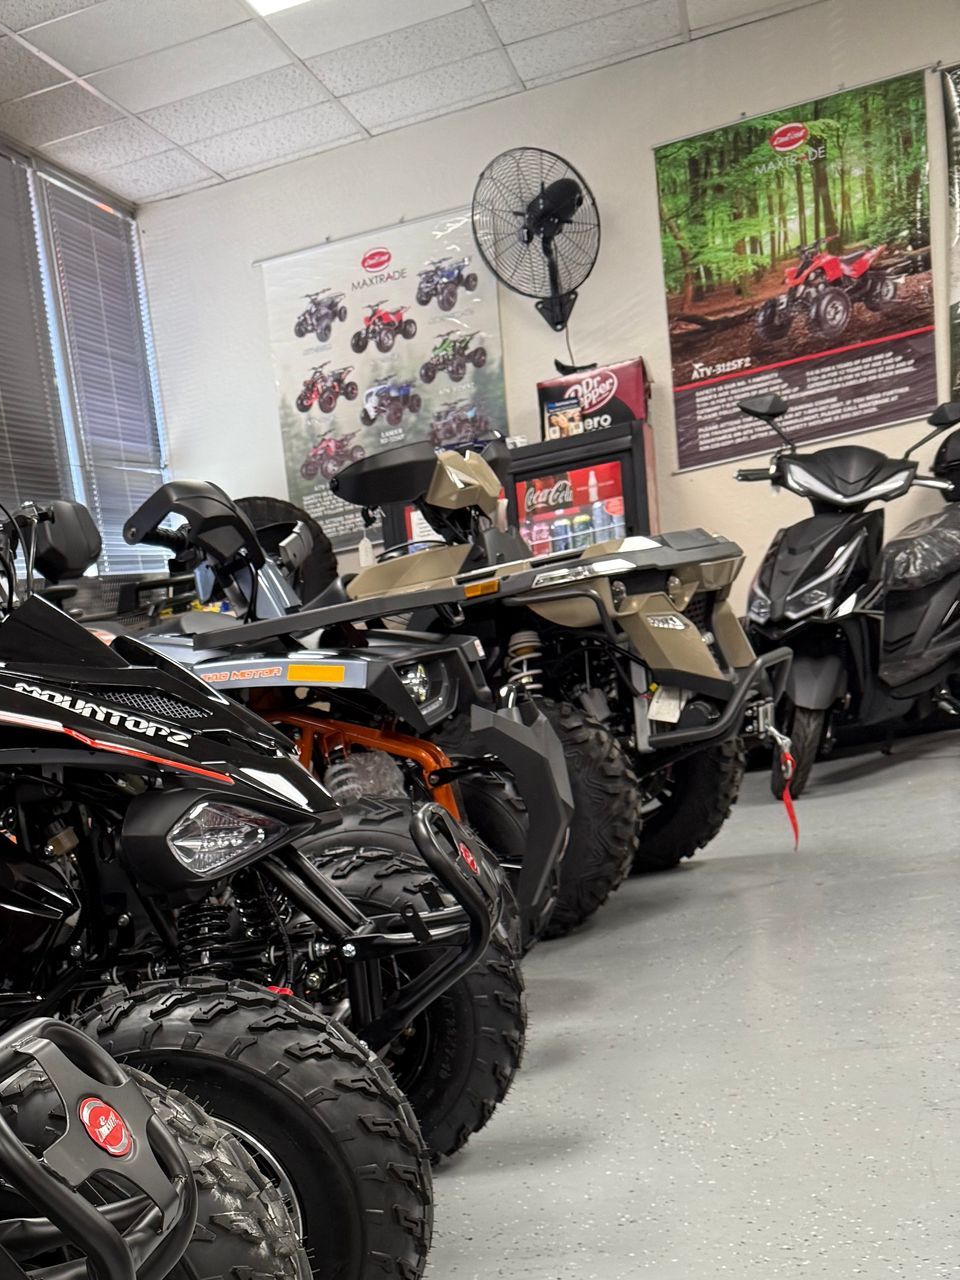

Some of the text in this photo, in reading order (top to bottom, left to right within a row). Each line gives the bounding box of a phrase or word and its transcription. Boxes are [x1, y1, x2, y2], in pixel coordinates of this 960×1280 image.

[351, 268, 407, 291] MAXTRADE
[582, 376, 601, 392] Dr
[583, 413, 612, 431] ero
[230, 667, 282, 680] MOTOR
